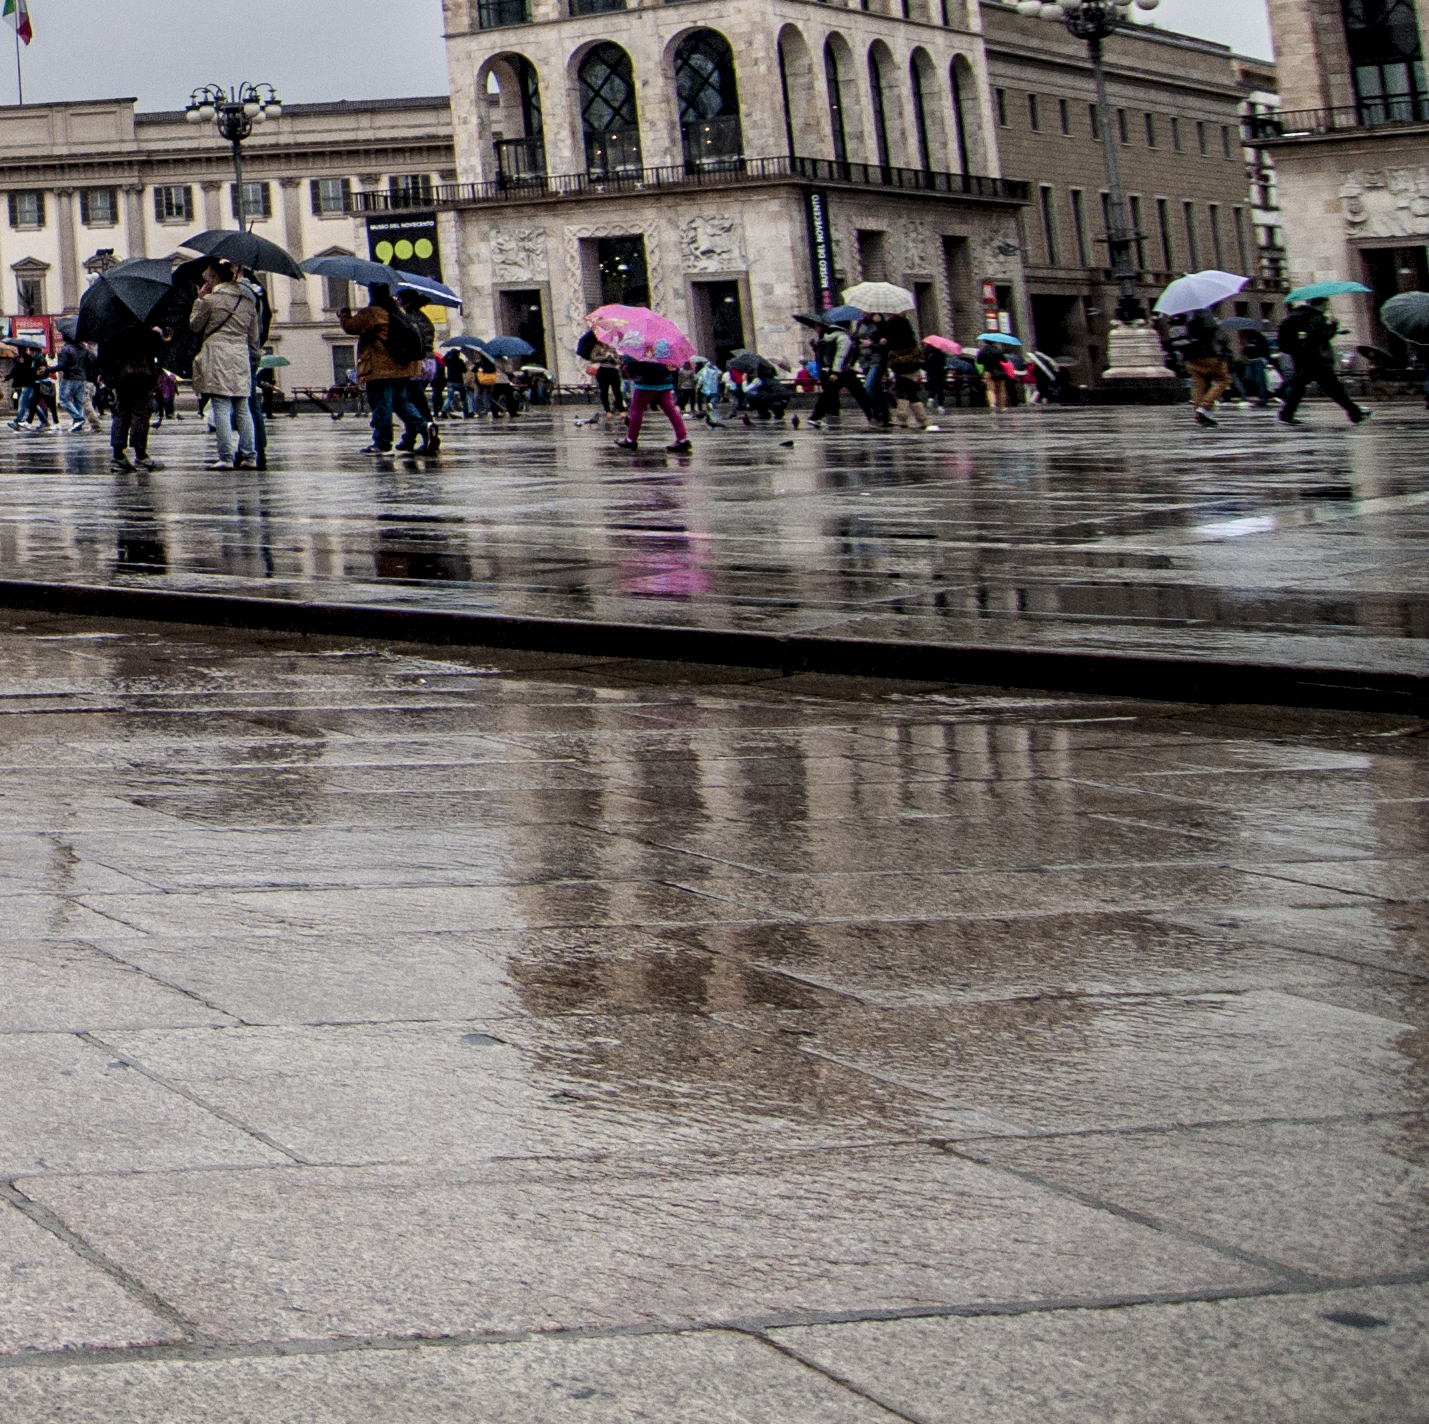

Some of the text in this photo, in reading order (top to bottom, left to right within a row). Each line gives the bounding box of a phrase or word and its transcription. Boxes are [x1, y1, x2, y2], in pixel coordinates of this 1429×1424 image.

[401, 221, 434, 229] NOVECENTO
[811, 194, 824, 242] NOVECENTO
[817, 244, 826, 258] DEL
[819, 260, 829, 287] MUSEO
